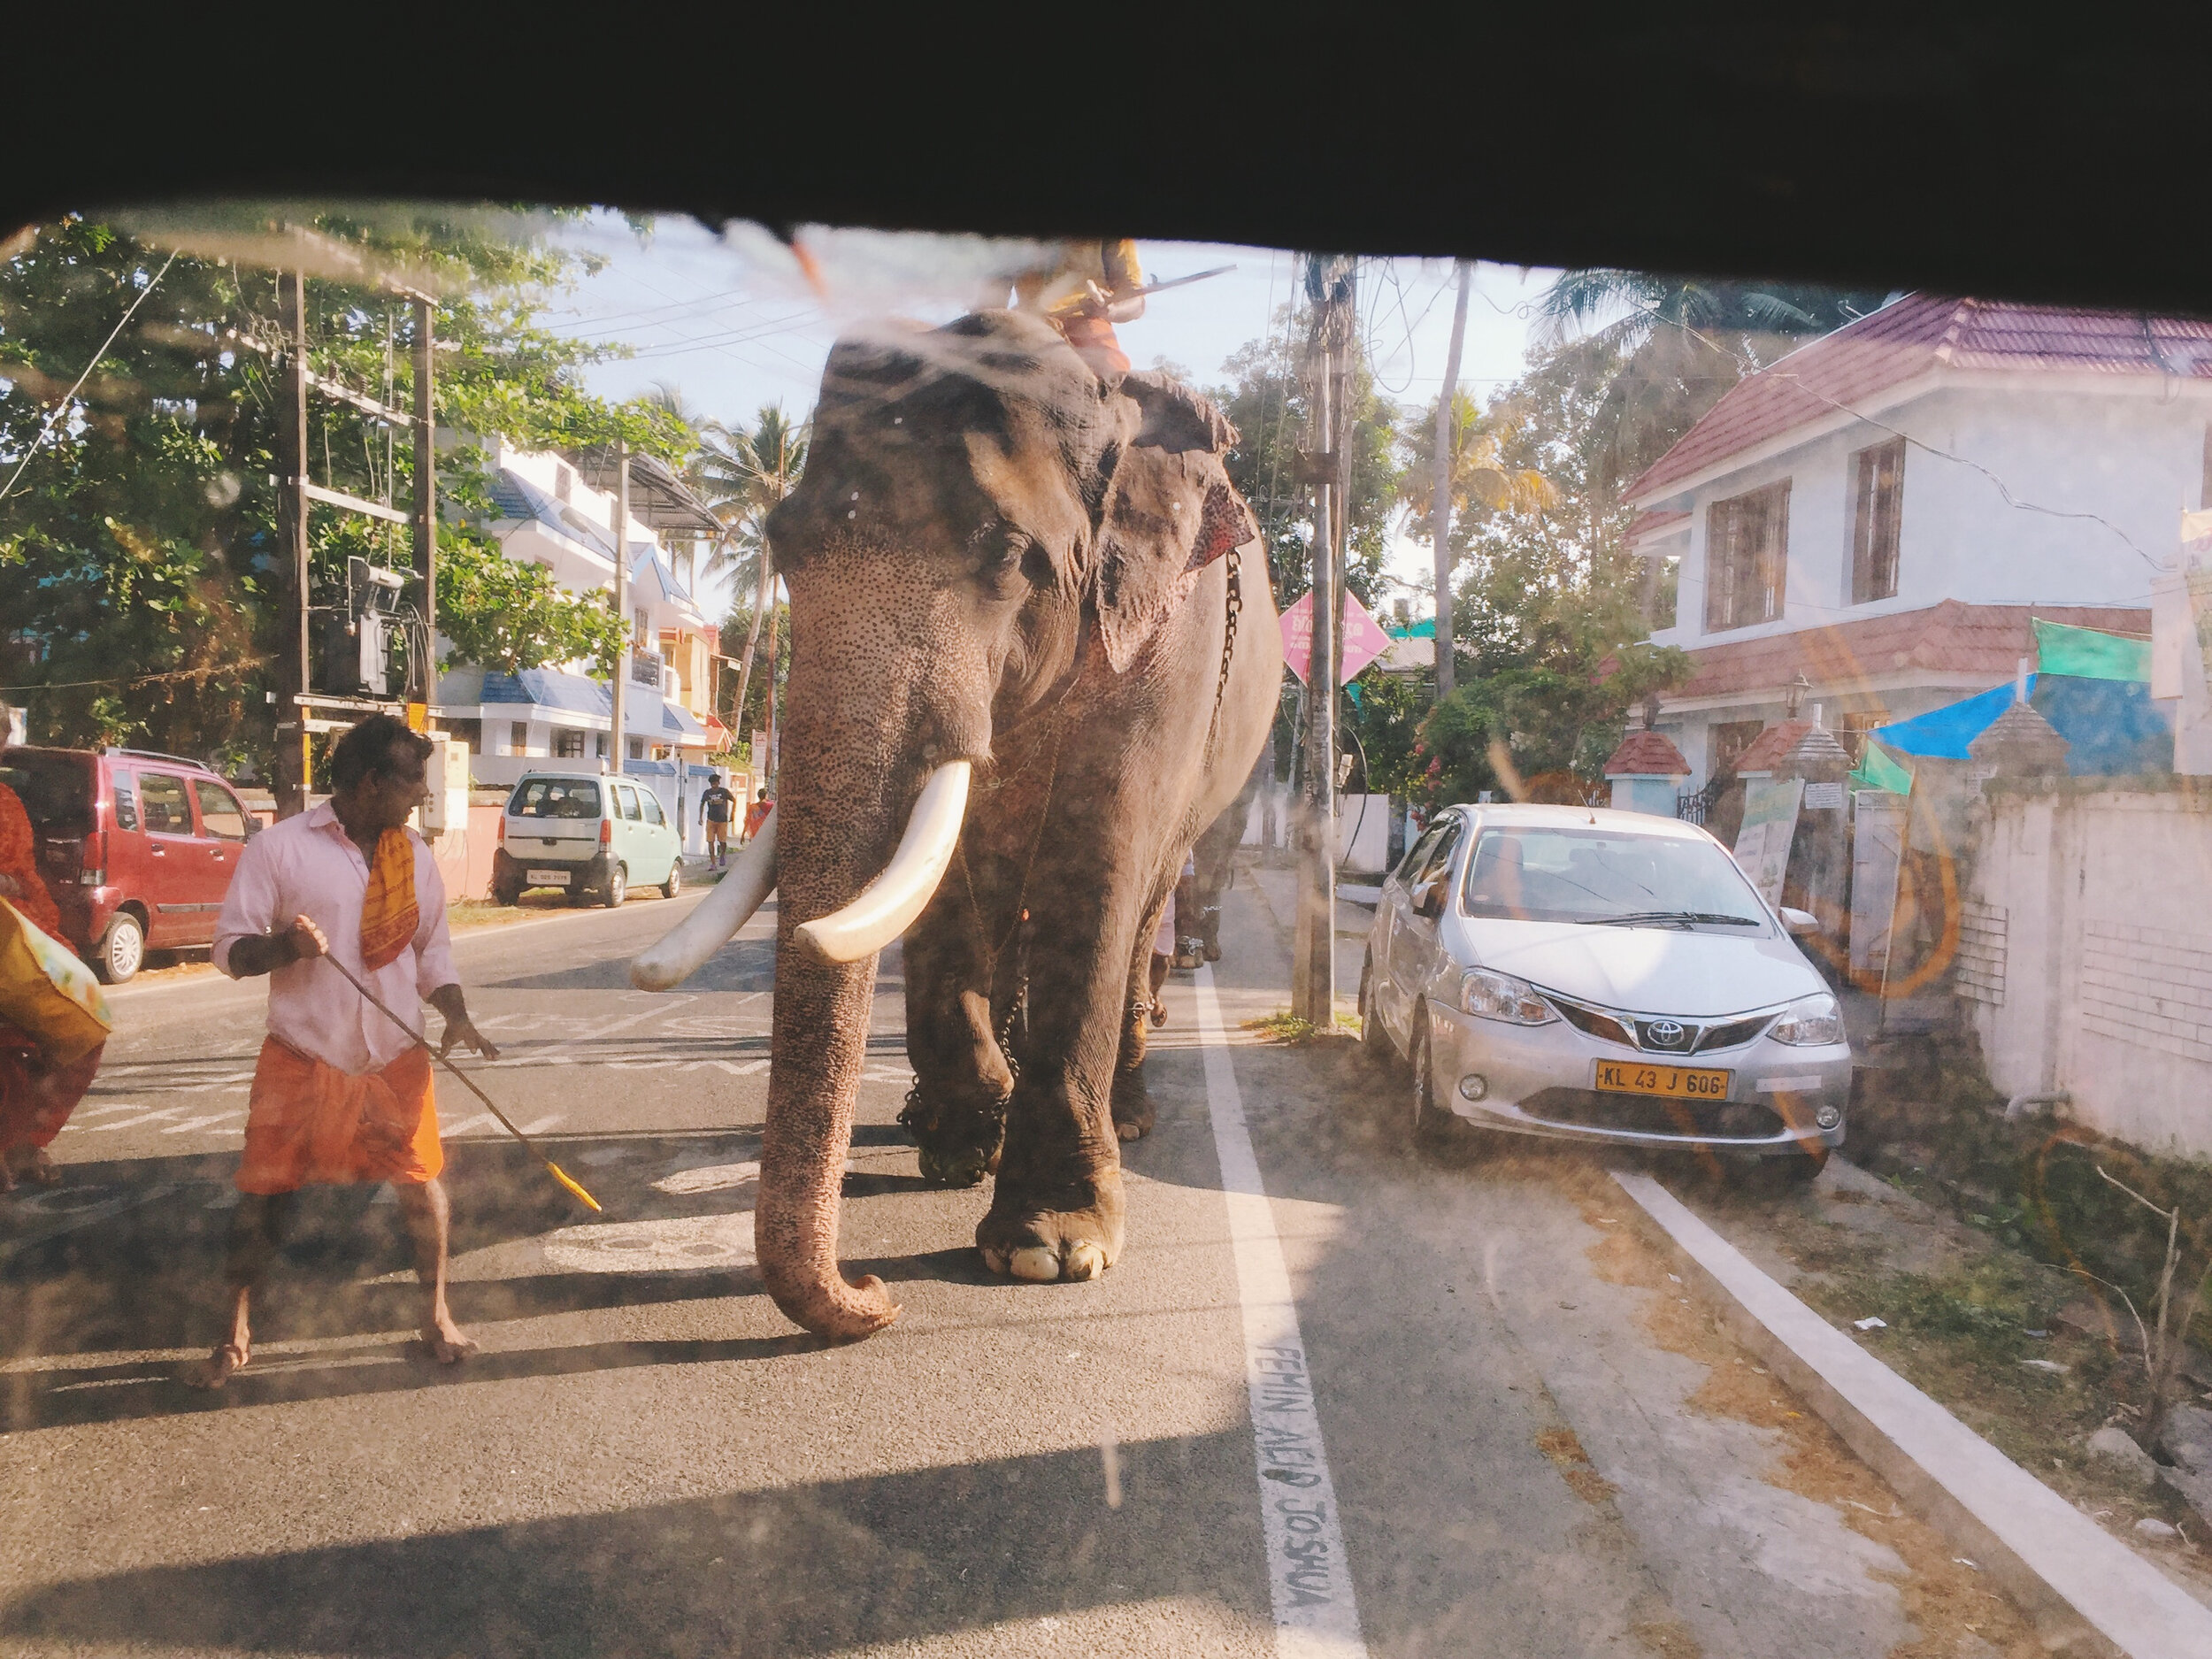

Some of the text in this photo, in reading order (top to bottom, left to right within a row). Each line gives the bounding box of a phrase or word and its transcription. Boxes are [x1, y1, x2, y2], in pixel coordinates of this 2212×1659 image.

[1604, 1067, 1720, 1094] KL 43 J 606
[1255, 1345, 1309, 1413] FEMIN
[1275, 1498, 1331, 1608] JOSHUA
